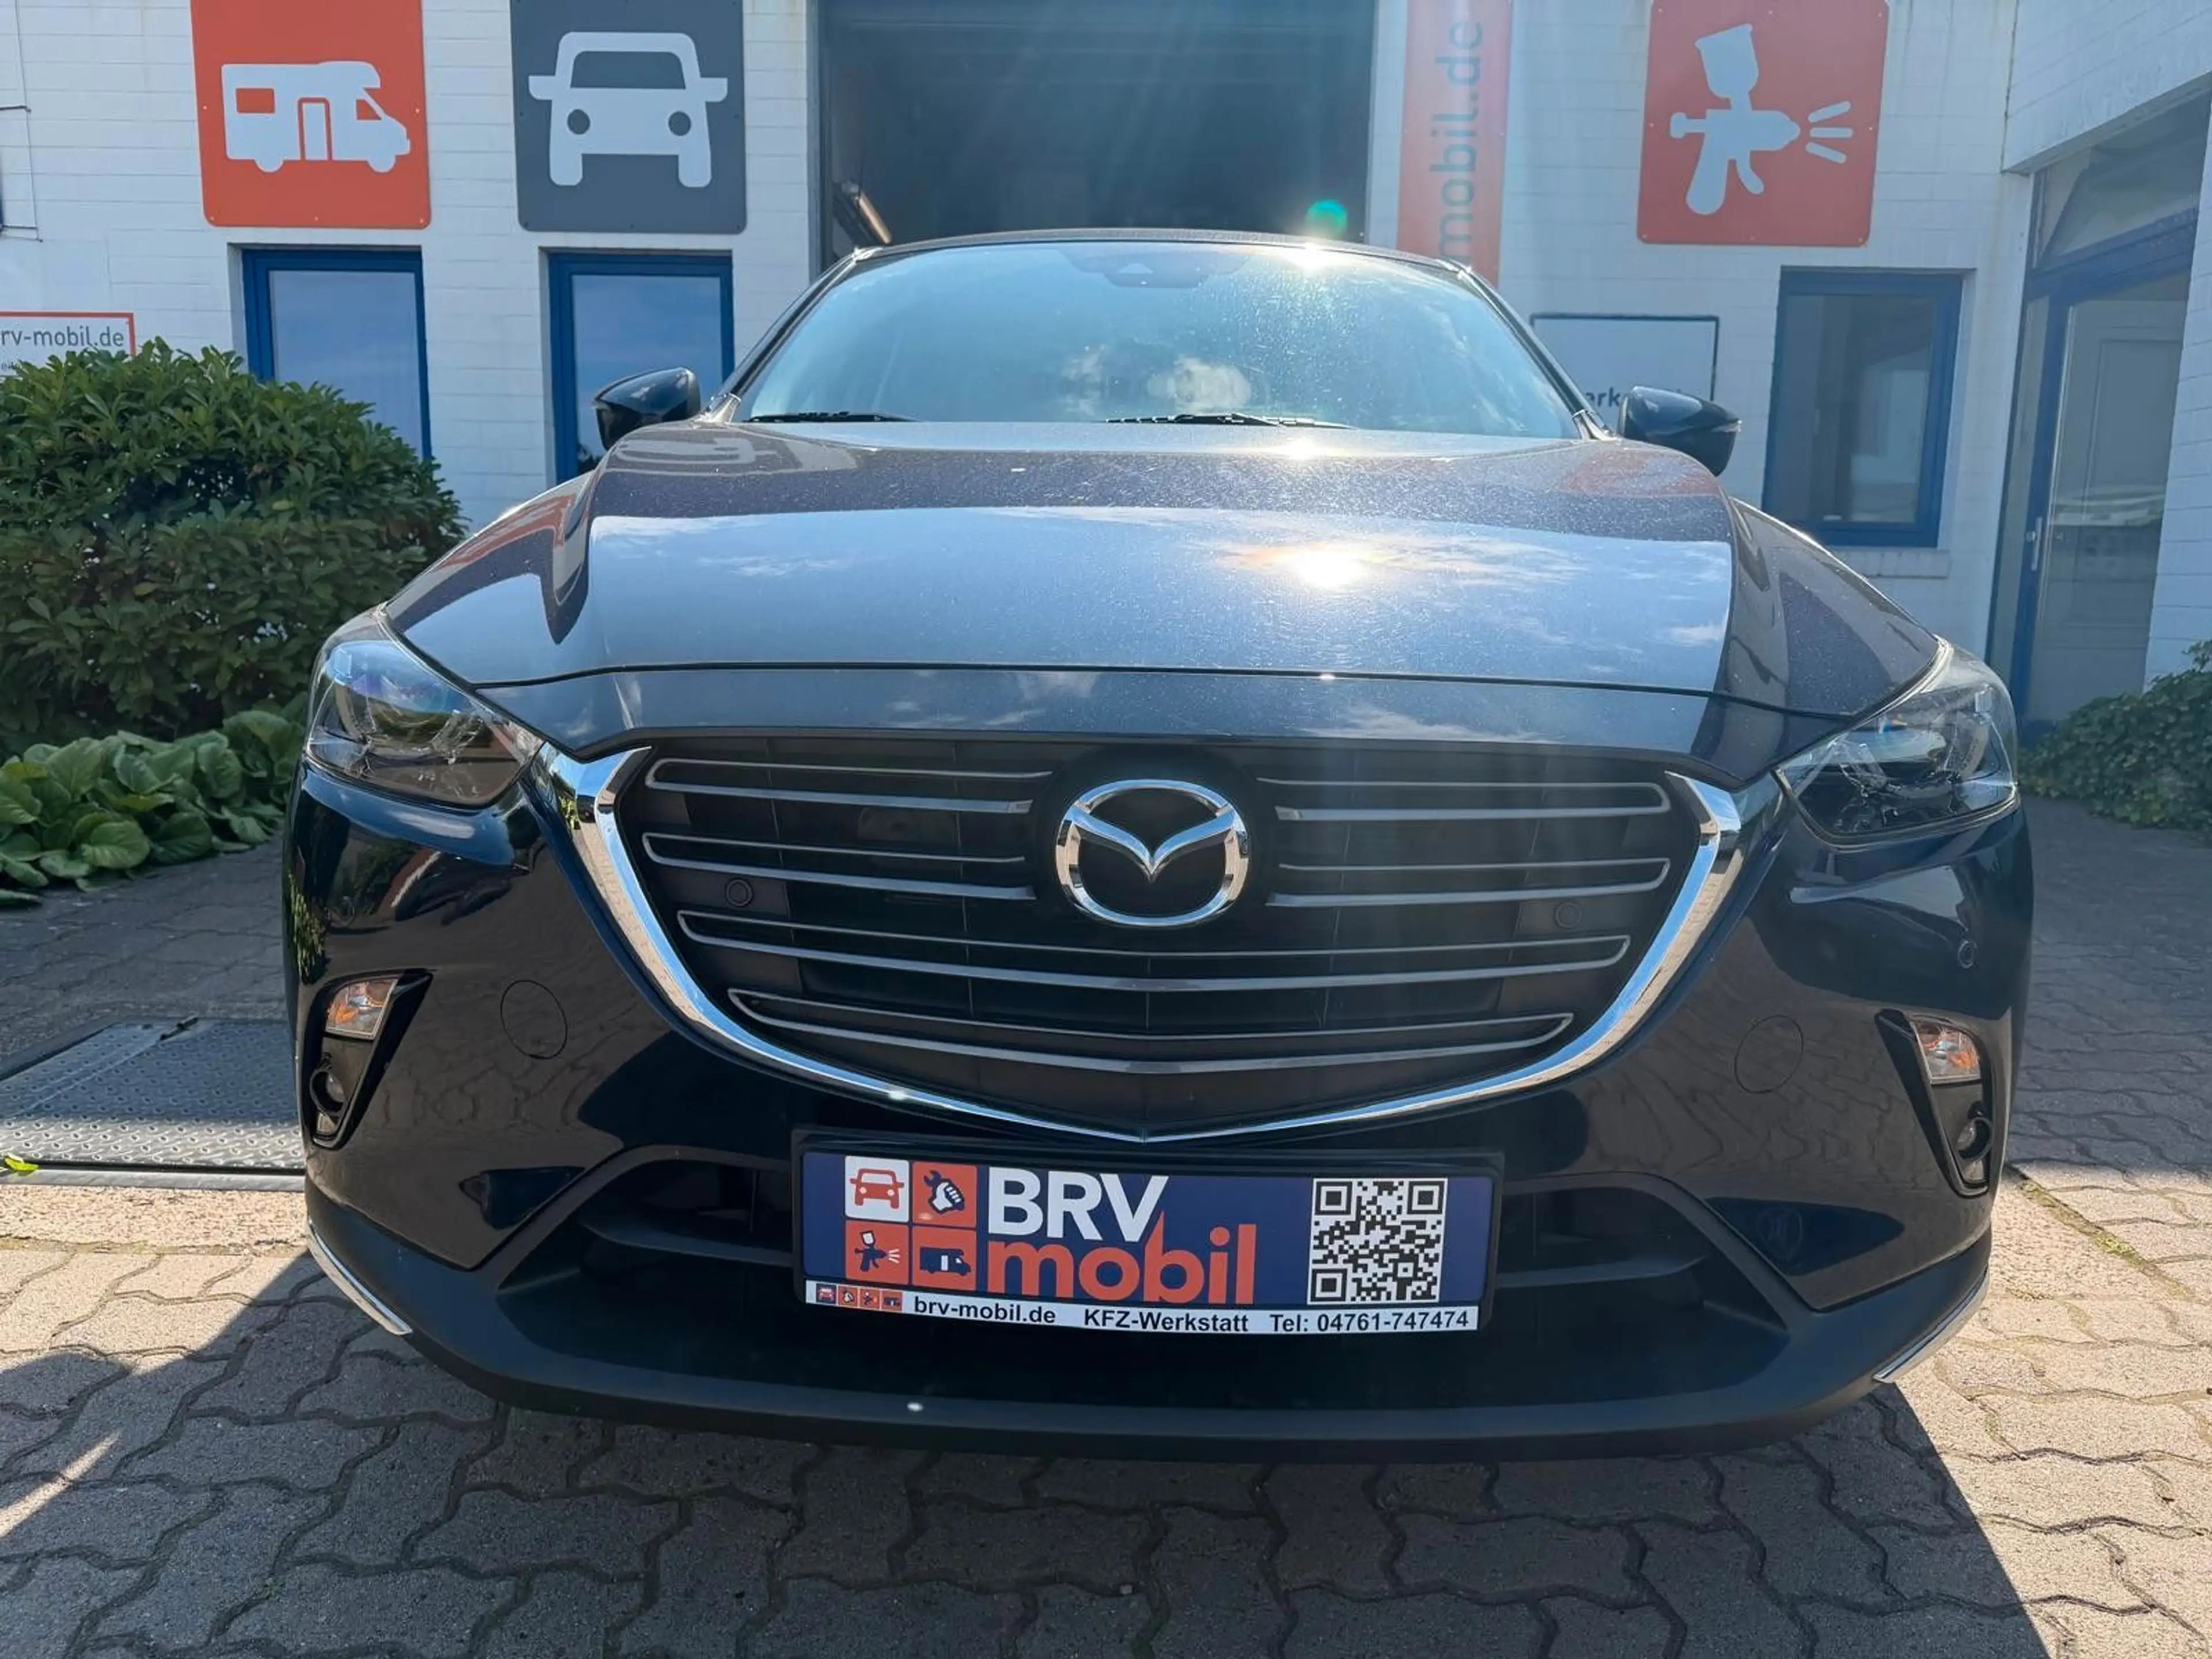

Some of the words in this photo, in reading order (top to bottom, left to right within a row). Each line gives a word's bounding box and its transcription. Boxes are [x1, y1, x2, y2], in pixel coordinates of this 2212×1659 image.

[1, 325, 124, 347] rv-mobil.de
[988, 1166, 1169, 1243] BRV
[988, 1210, 1256, 1305] mobil
[914, 1297, 1056, 1324] brv-mobil.de
[1084, 1309, 1249, 1332] KFZ-Werkstatt
[1270, 1314, 1309, 1332] Tel:
[1317, 1310, 1469, 1332] 04761-747474
